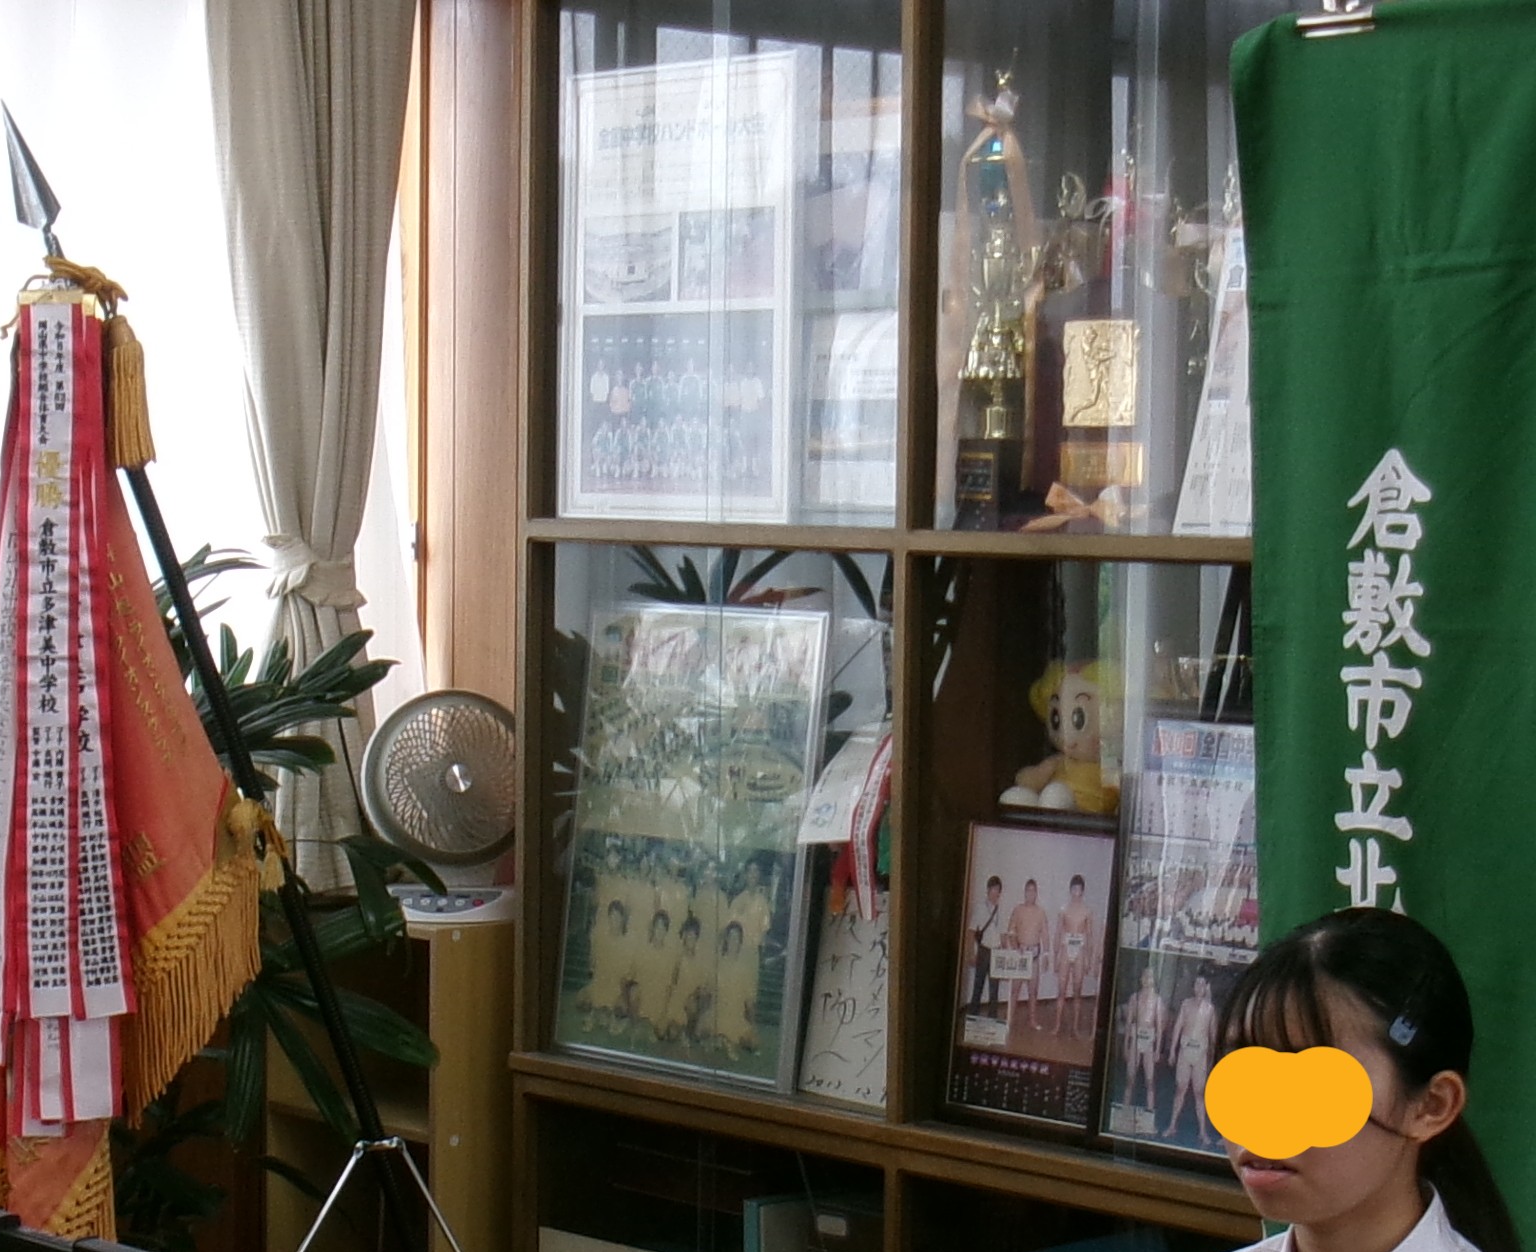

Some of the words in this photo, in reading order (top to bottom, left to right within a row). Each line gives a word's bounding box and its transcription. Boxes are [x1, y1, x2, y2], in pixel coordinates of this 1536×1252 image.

[38, 517, 60, 715] 倉敷市立多津美中学校
